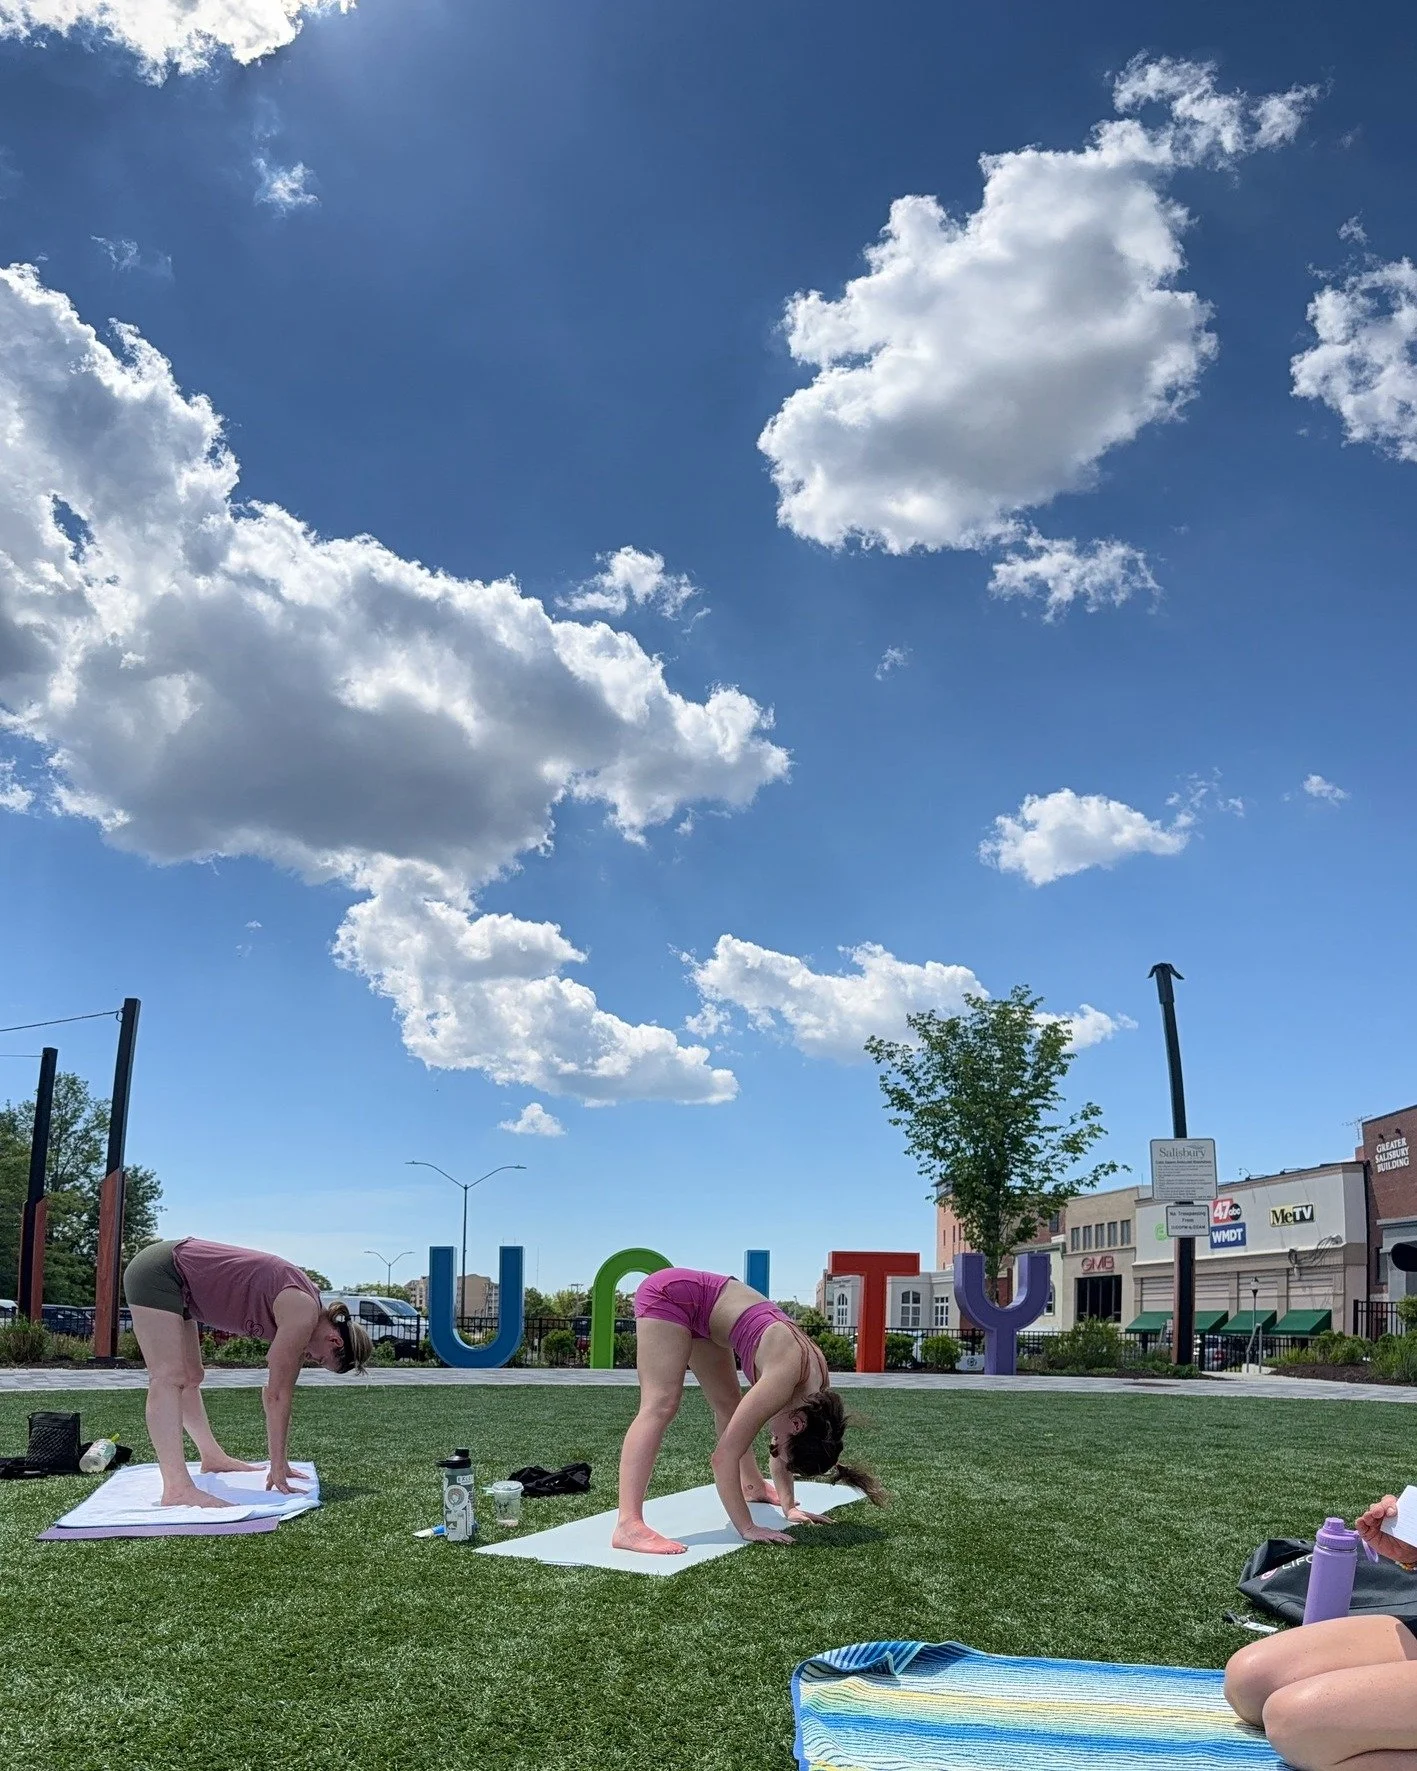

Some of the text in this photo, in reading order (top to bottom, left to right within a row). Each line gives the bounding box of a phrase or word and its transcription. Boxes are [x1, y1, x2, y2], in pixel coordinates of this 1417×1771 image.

[1159, 1147, 1206, 1159] Salisbury
[1376, 1137, 1407, 1153] GREATER
[1375, 1146, 1410, 1163] SALISBURY
[1377, 1157, 1410, 1173] BUILDING
[1213, 1201, 1241, 1220] 47 abc
[1271, 1205, 1313, 1226] MeTV
[1211, 1228, 1243, 1244] WMDT
